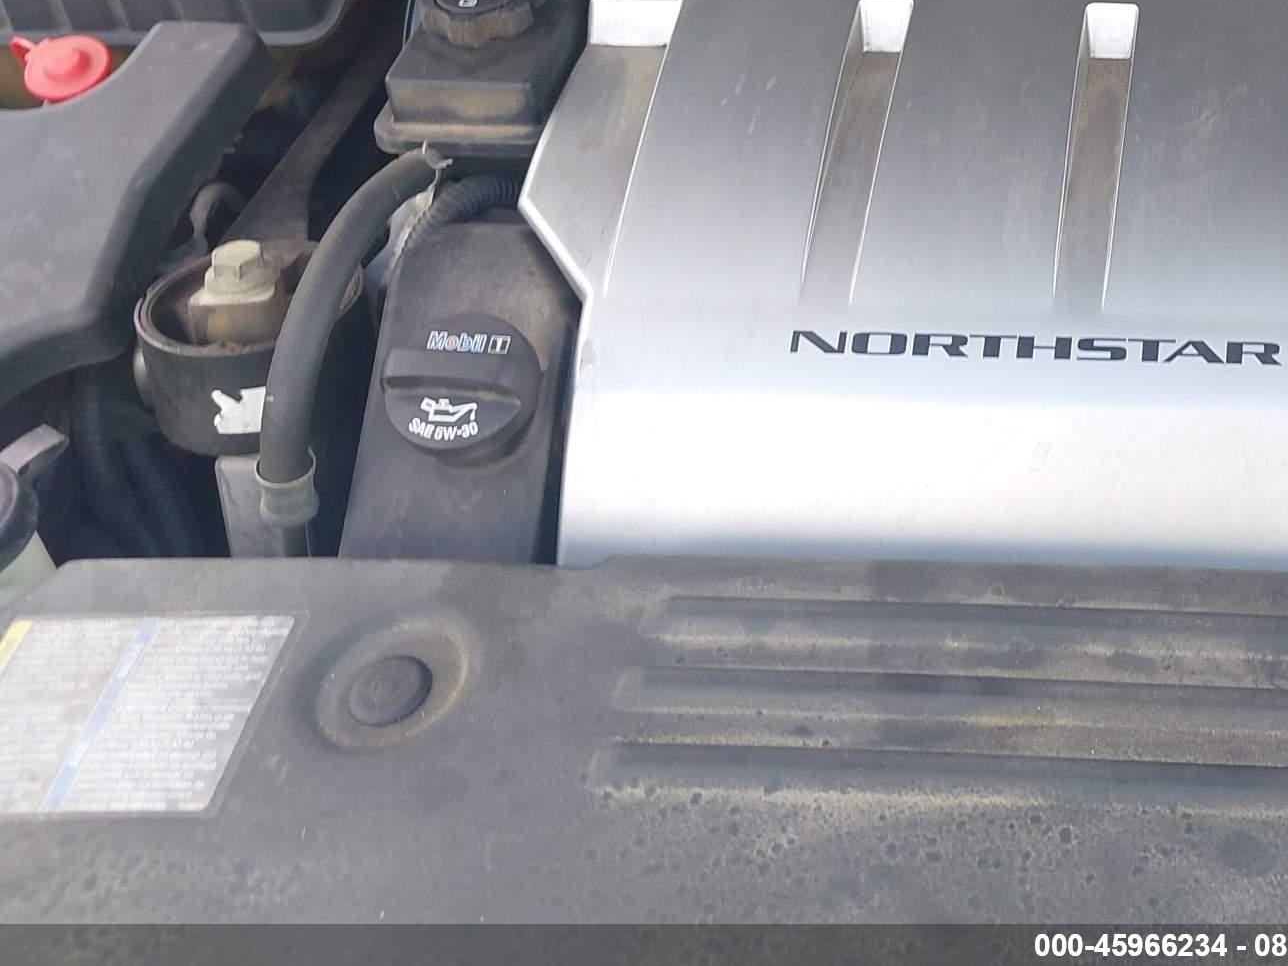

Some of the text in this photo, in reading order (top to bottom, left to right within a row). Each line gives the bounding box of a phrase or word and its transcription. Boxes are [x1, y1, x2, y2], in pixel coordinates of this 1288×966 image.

[426, 330, 487, 353] Mobil
[790, 330, 1281, 365] NORTHSTAR
[408, 417, 479, 441] SAE 5W-30
